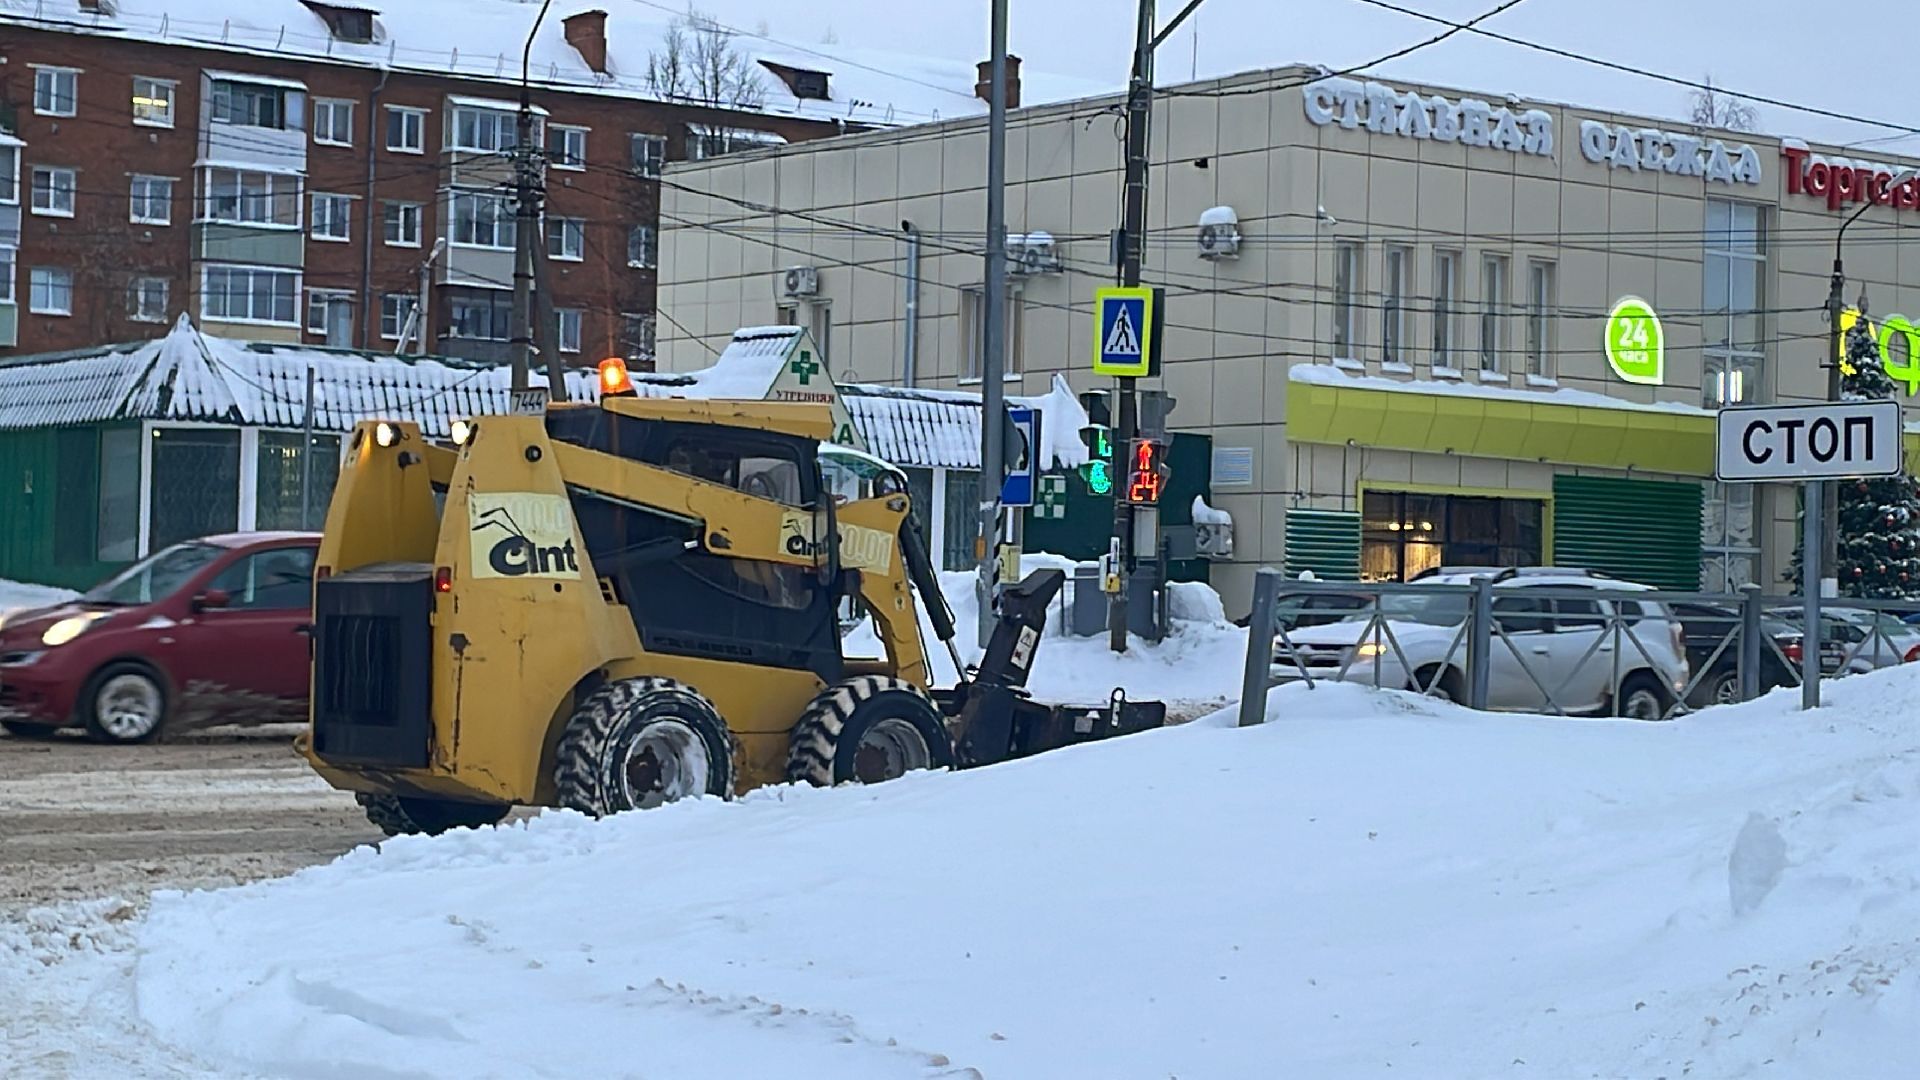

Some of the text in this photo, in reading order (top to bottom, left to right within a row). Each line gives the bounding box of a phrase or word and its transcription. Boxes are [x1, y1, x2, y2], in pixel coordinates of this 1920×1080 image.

[1303, 79, 1761, 185] СТИЛЬНАЯ ОДЕЖДА
[1783, 143, 1920, 211] Торгов
[1618, 317, 1650, 349] 24
[514, 393, 543, 412] 7444
[1742, 416, 1874, 464] СТОП
[1131, 472, 1158, 501] 24
